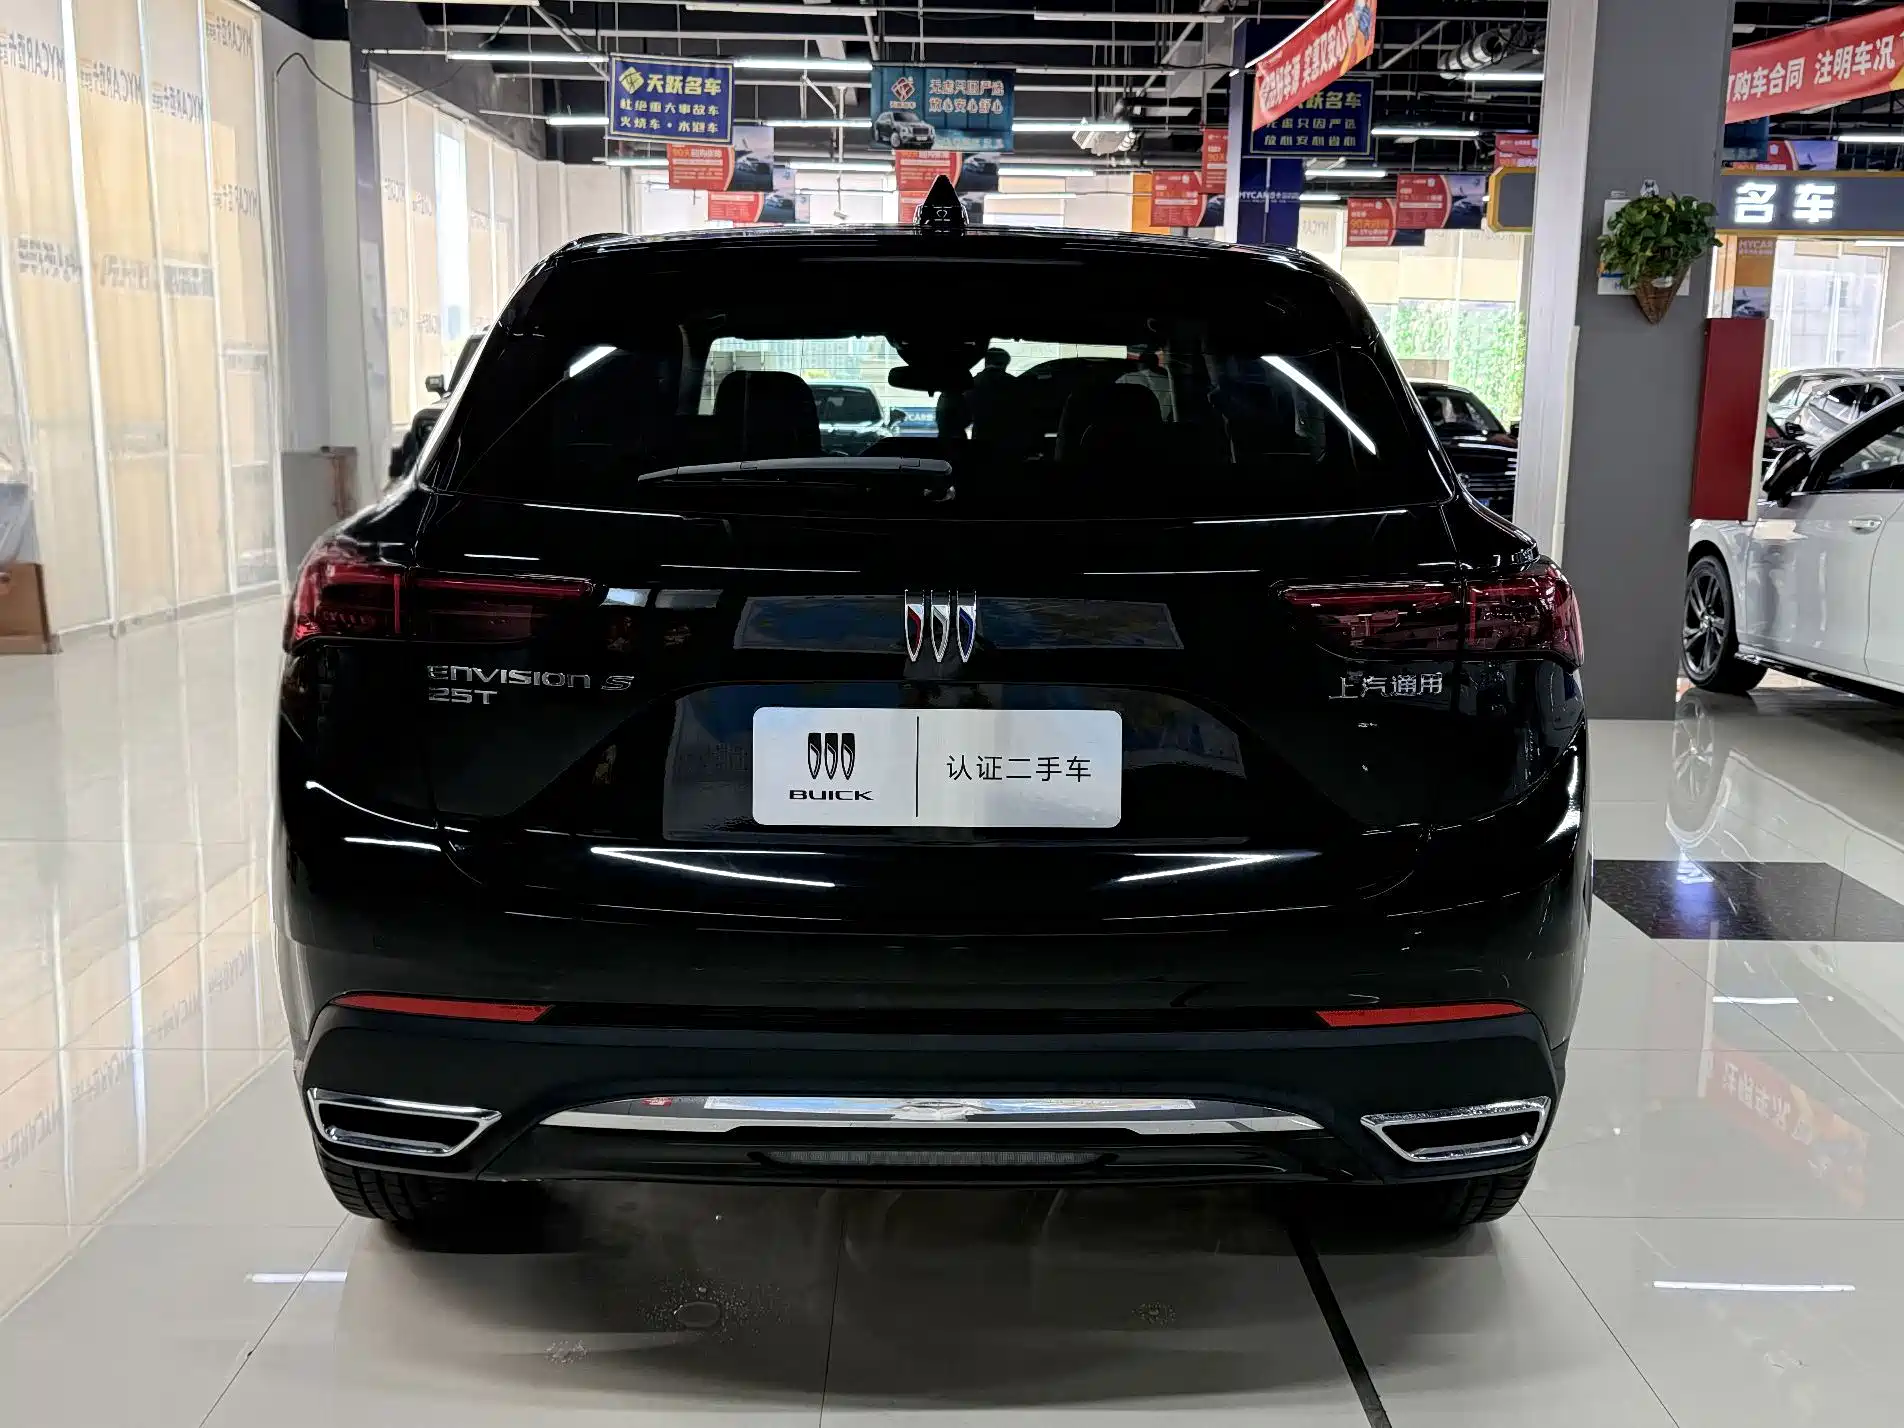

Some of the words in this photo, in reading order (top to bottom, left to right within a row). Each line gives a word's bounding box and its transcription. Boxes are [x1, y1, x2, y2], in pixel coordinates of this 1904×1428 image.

[1814, 35, 1896, 84] 注明车况
[1298, 91, 1362, 109] 跃名车
[1734, 182, 1837, 224] 名车
[601, 675, 635, 691] S
[1328, 672, 1443, 700] 上汽通用
[428, 687, 498, 705] 25T
[946, 755, 1092, 782] 认证二手车
[789, 789, 874, 801] BUICK
